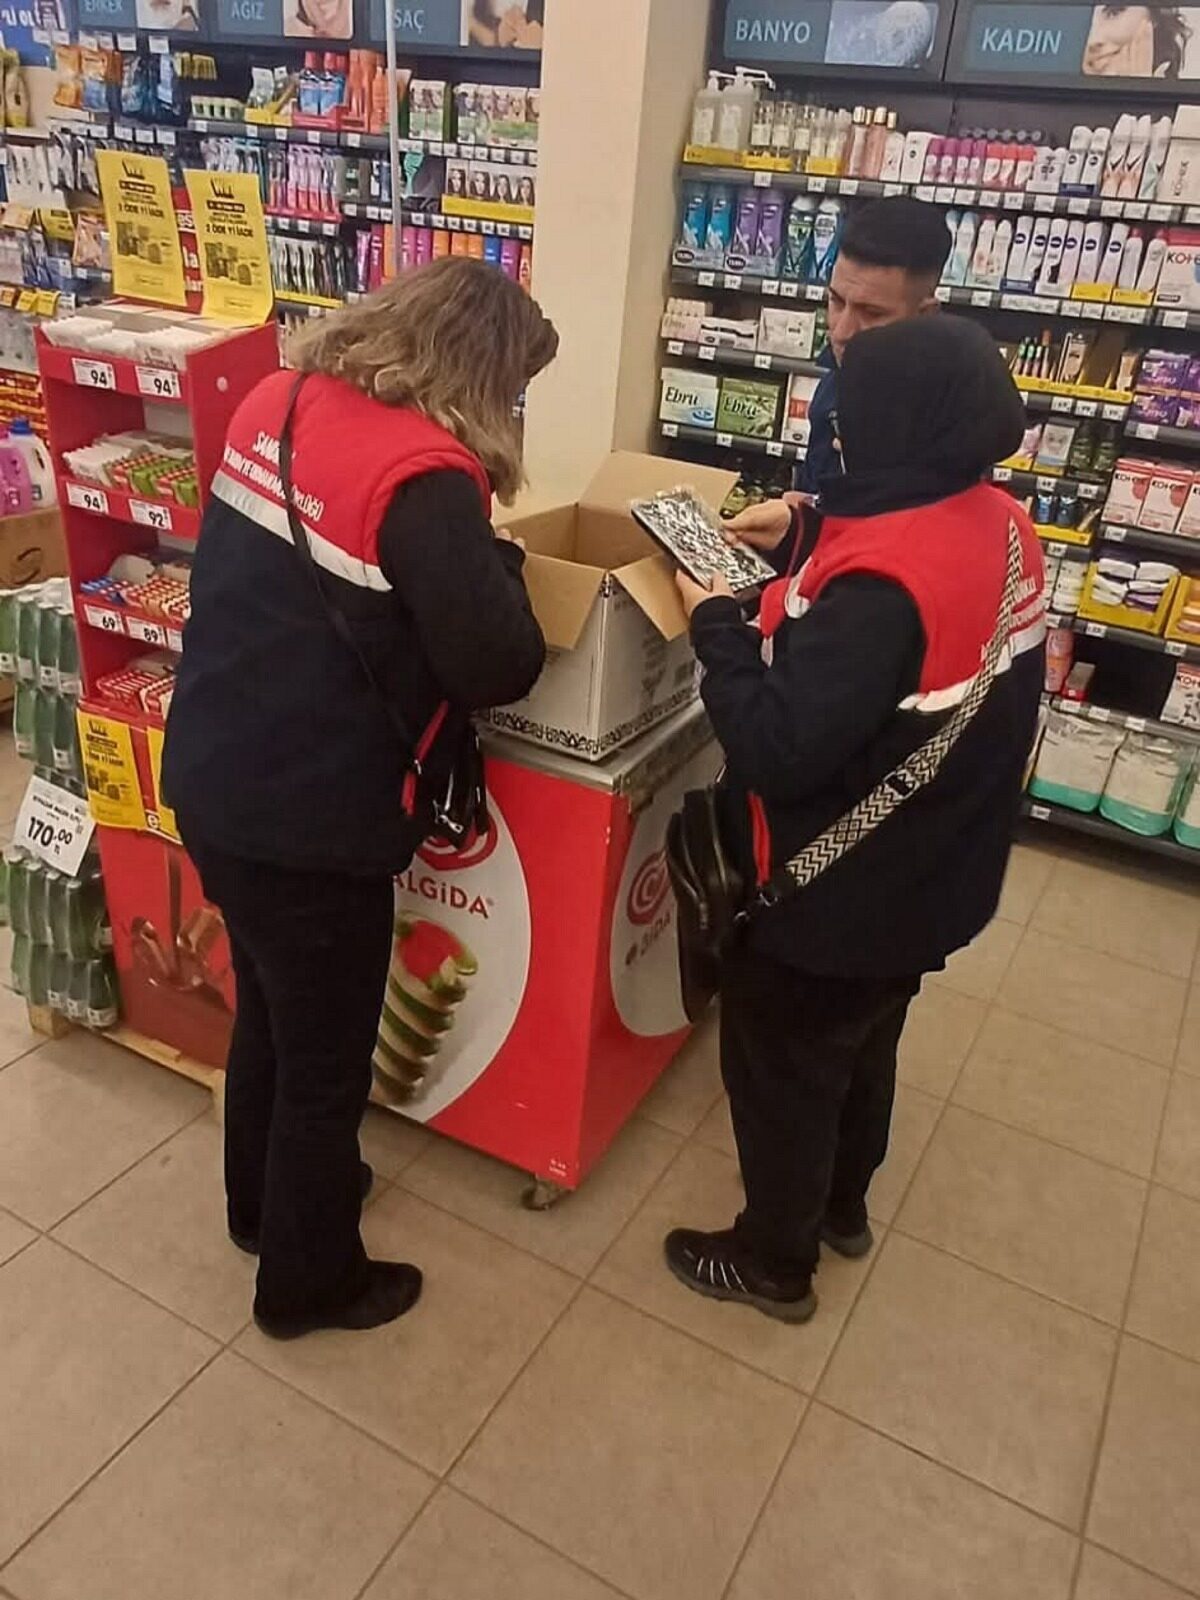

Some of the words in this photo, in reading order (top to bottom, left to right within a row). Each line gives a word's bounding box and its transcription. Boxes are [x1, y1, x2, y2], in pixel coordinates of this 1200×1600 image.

[394, 9, 425, 34] SAÇ
[735, 18, 811, 44] BANYO
[981, 27, 1062, 55] KADIN
[91, 369, 108, 386] 94
[153, 377, 172, 395] 94
[665, 386, 699, 406] Ebru
[723, 396, 761, 417] Ebru
[83, 493, 101, 510] 94
[148, 510, 165, 527] 92
[102, 615, 116, 630] 69
[143, 627, 159, 642] 89
